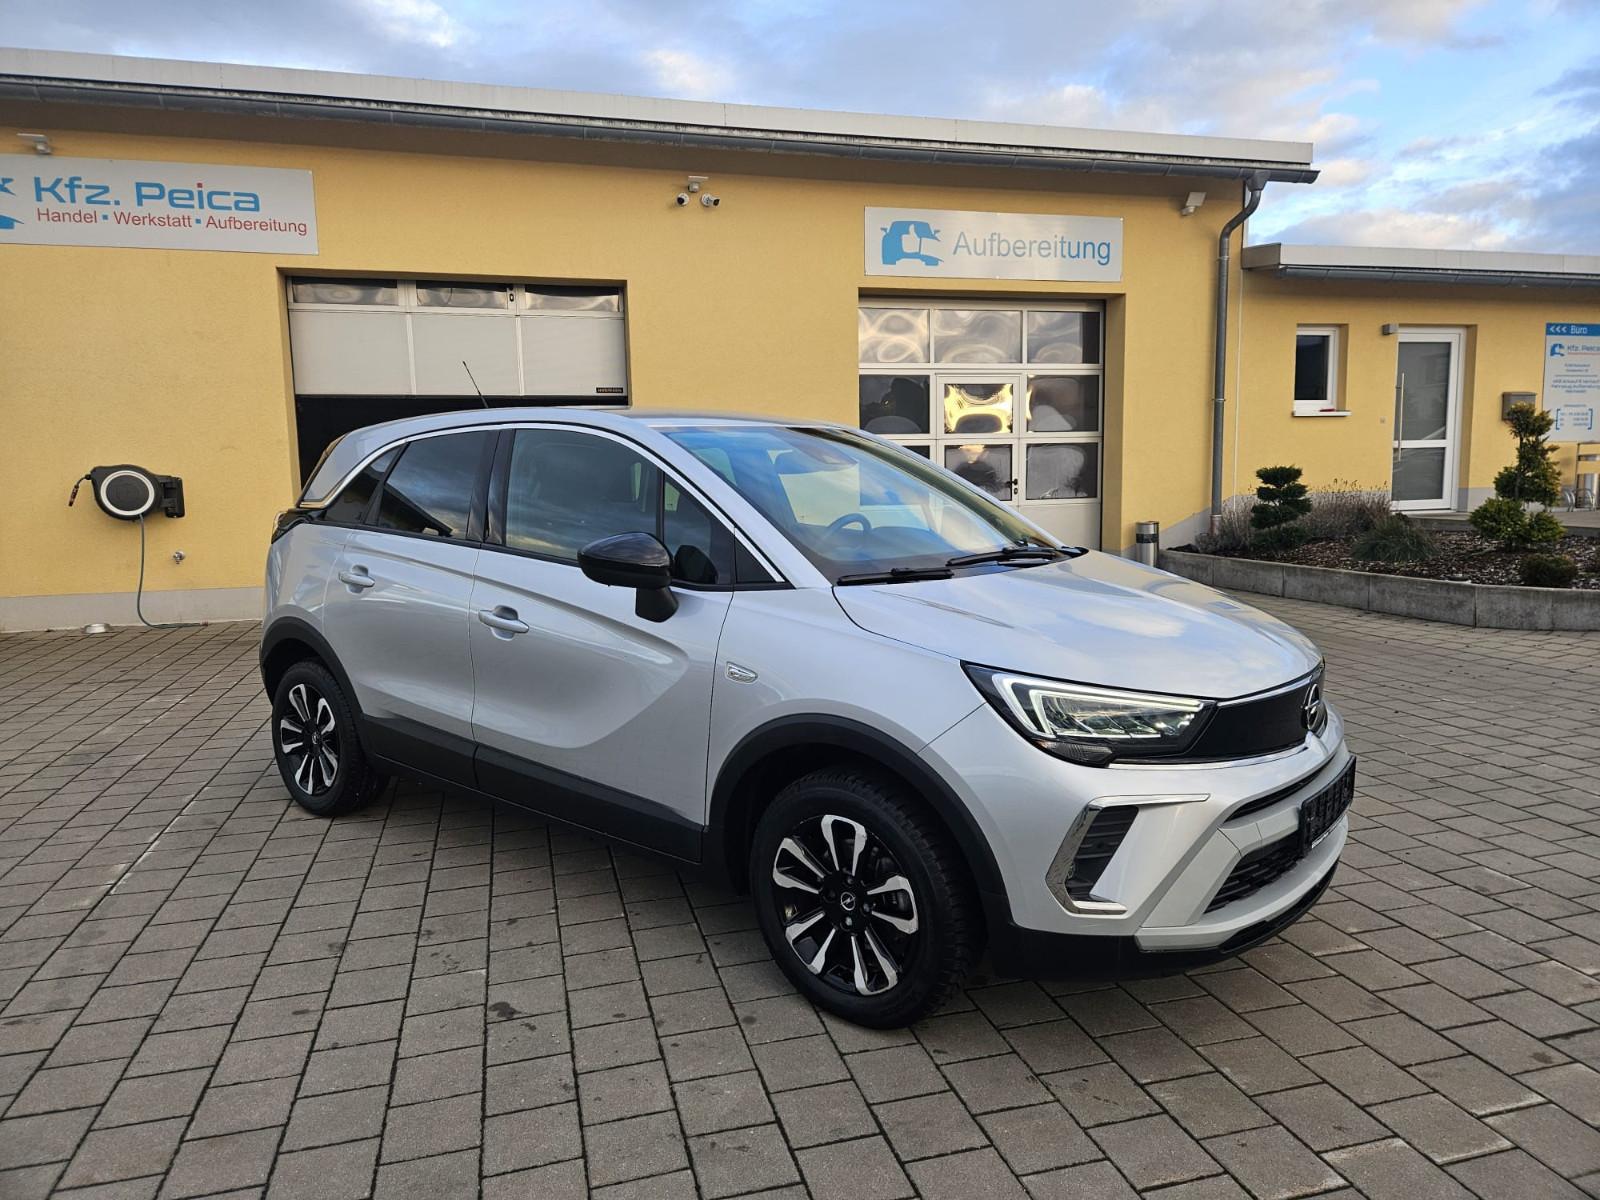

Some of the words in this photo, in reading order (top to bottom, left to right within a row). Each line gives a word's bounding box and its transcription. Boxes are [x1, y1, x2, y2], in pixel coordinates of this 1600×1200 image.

[34, 176, 121, 206] Kfz.
[135, 181, 260, 213] Peica
[37, 208, 97, 224] Handel
[113, 211, 193, 228] Werkstatt
[206, 215, 308, 237] Aufbereitung
[952, 231, 1111, 266] Aufbereitung
